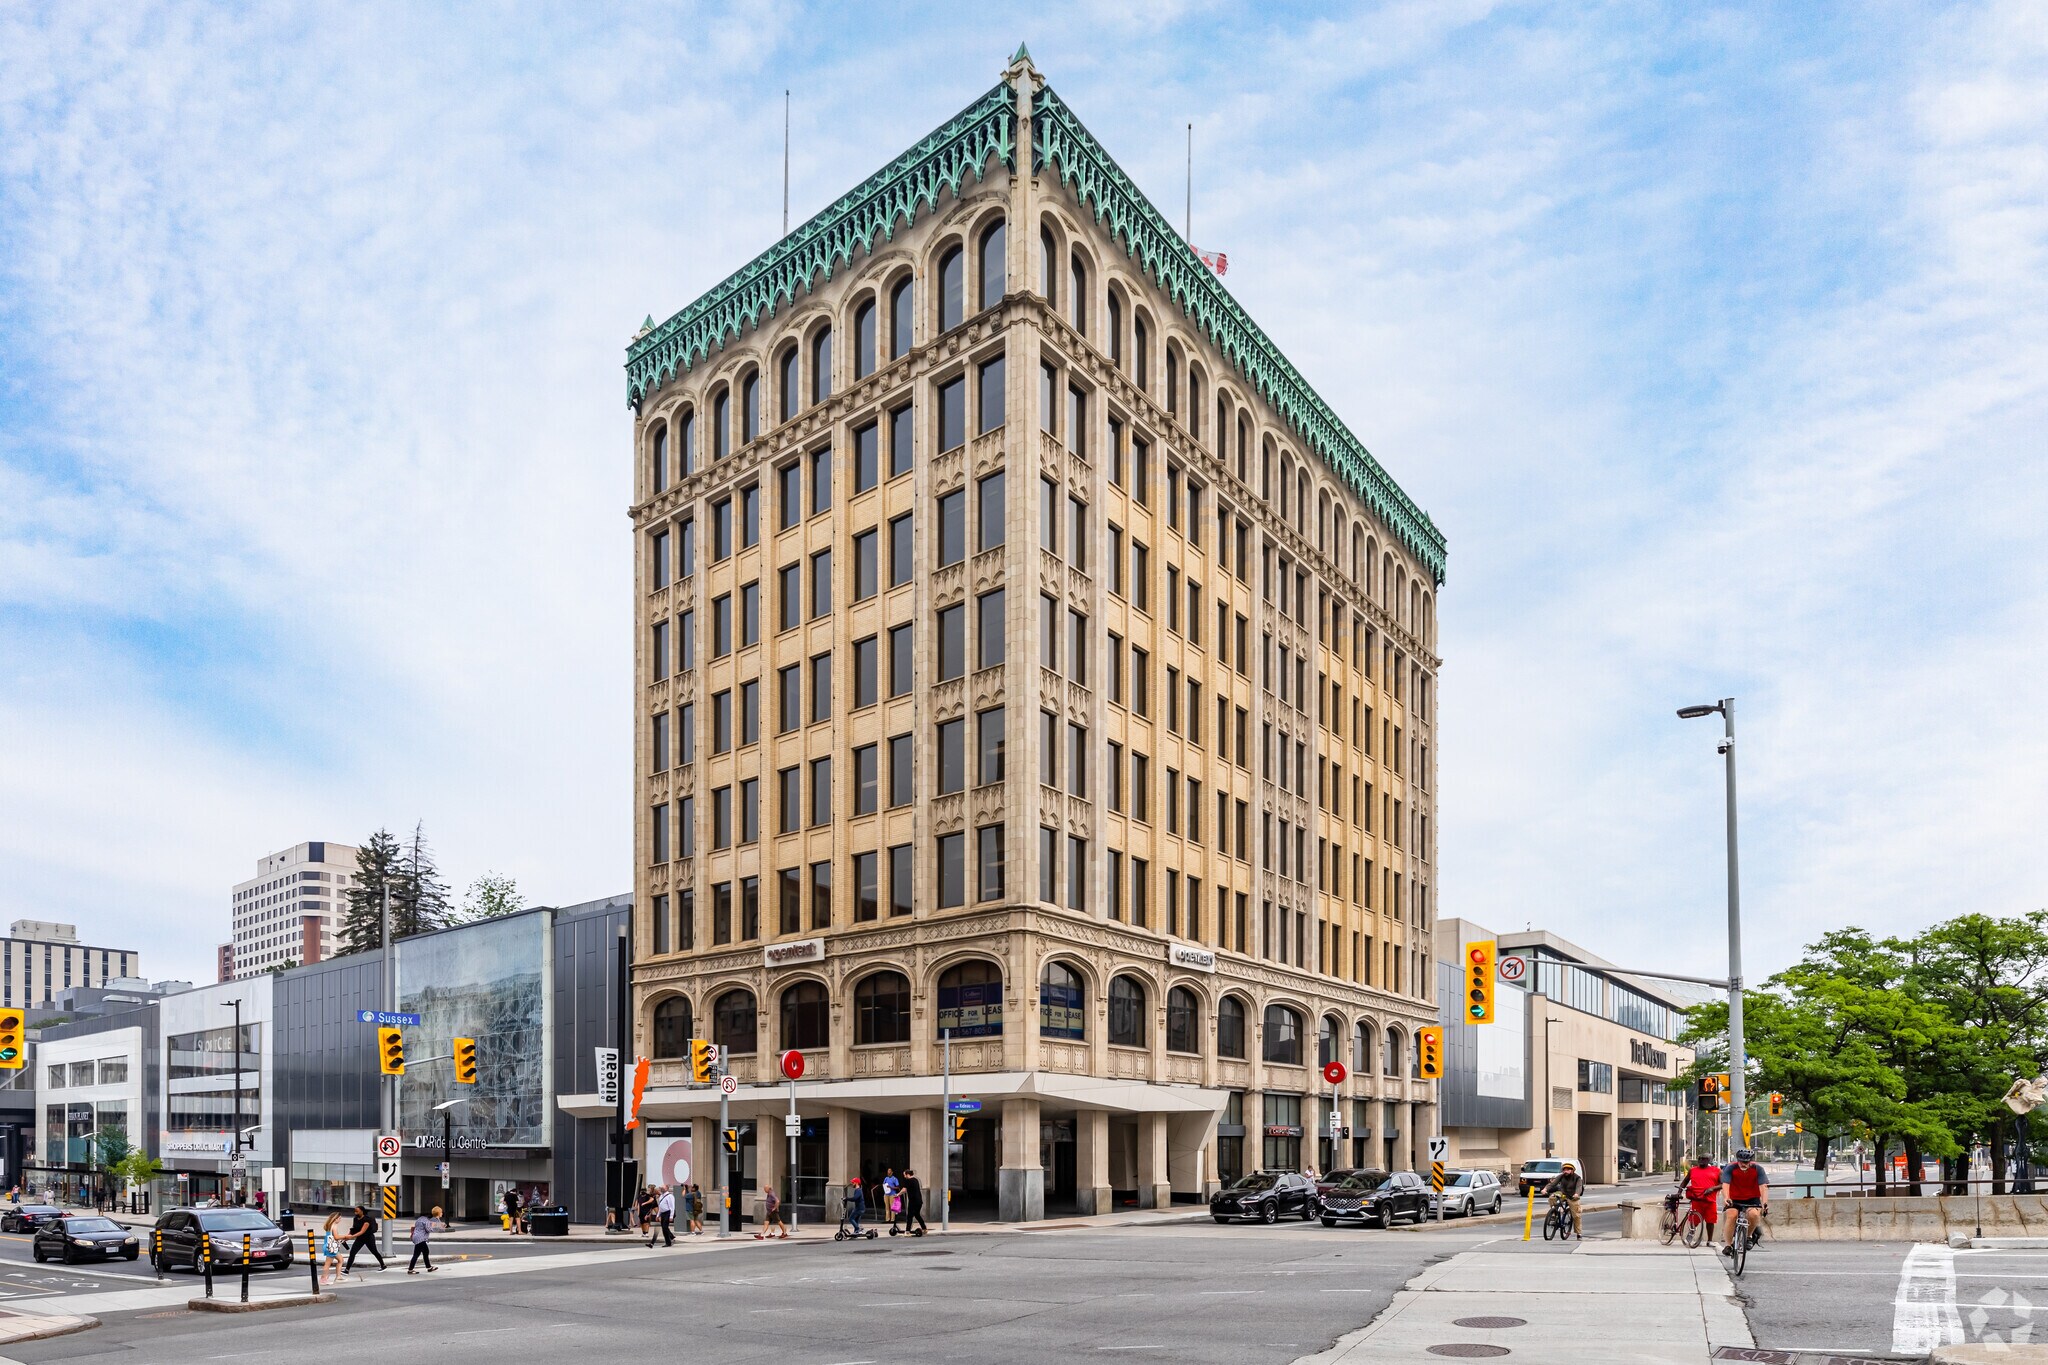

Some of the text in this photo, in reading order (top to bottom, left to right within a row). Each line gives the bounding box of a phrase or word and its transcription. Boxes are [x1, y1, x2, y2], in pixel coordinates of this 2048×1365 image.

[378, 1012, 414, 1025] Sussex
[429, 1135, 457, 1149] Rideu
[458, 1135, 488, 1149] Centre
